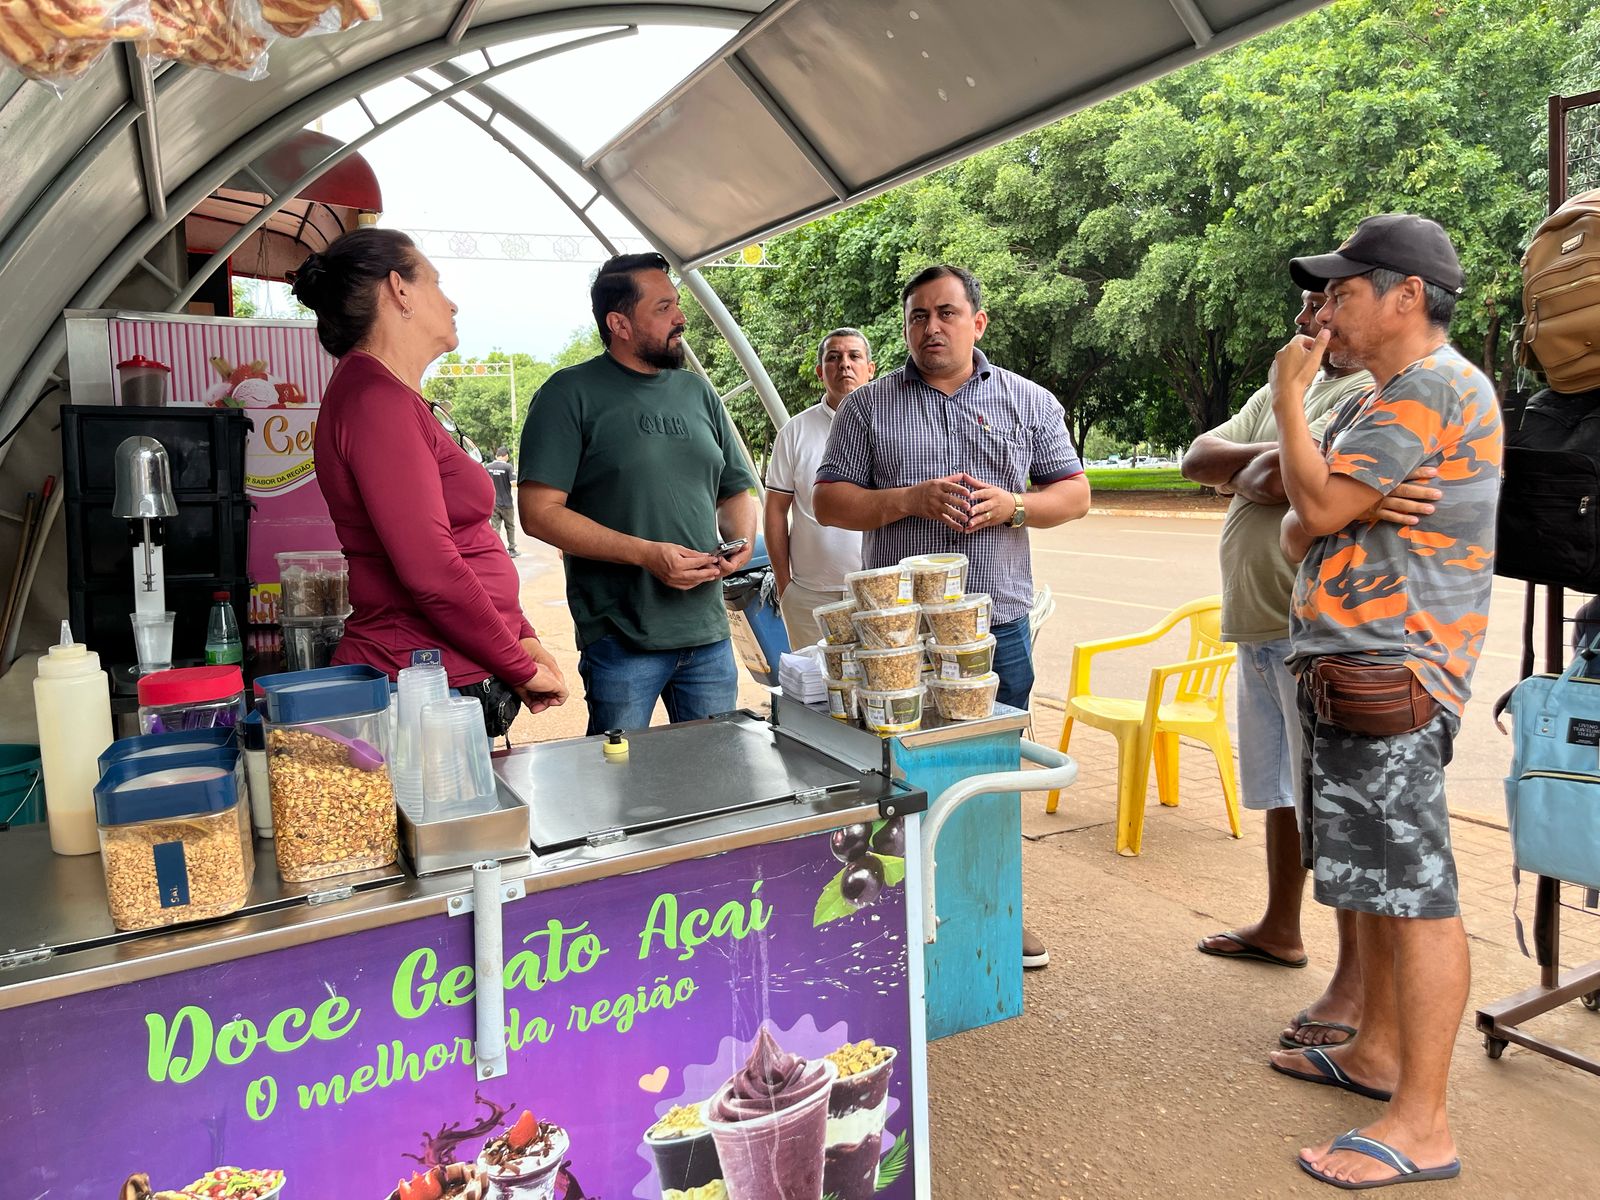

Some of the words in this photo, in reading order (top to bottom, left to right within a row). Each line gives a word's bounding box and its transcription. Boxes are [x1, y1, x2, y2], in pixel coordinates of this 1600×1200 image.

[287, 463, 311, 480] REGIÃO
[145, 996, 362, 1083] Doce
[392, 919, 610, 1019] Geato
[638, 880, 774, 961] Açaí
[245, 1075, 278, 1121] O
[297, 1036, 477, 1110] melhor
[503, 1007, 555, 1051] da
[566, 974, 700, 1034] região
